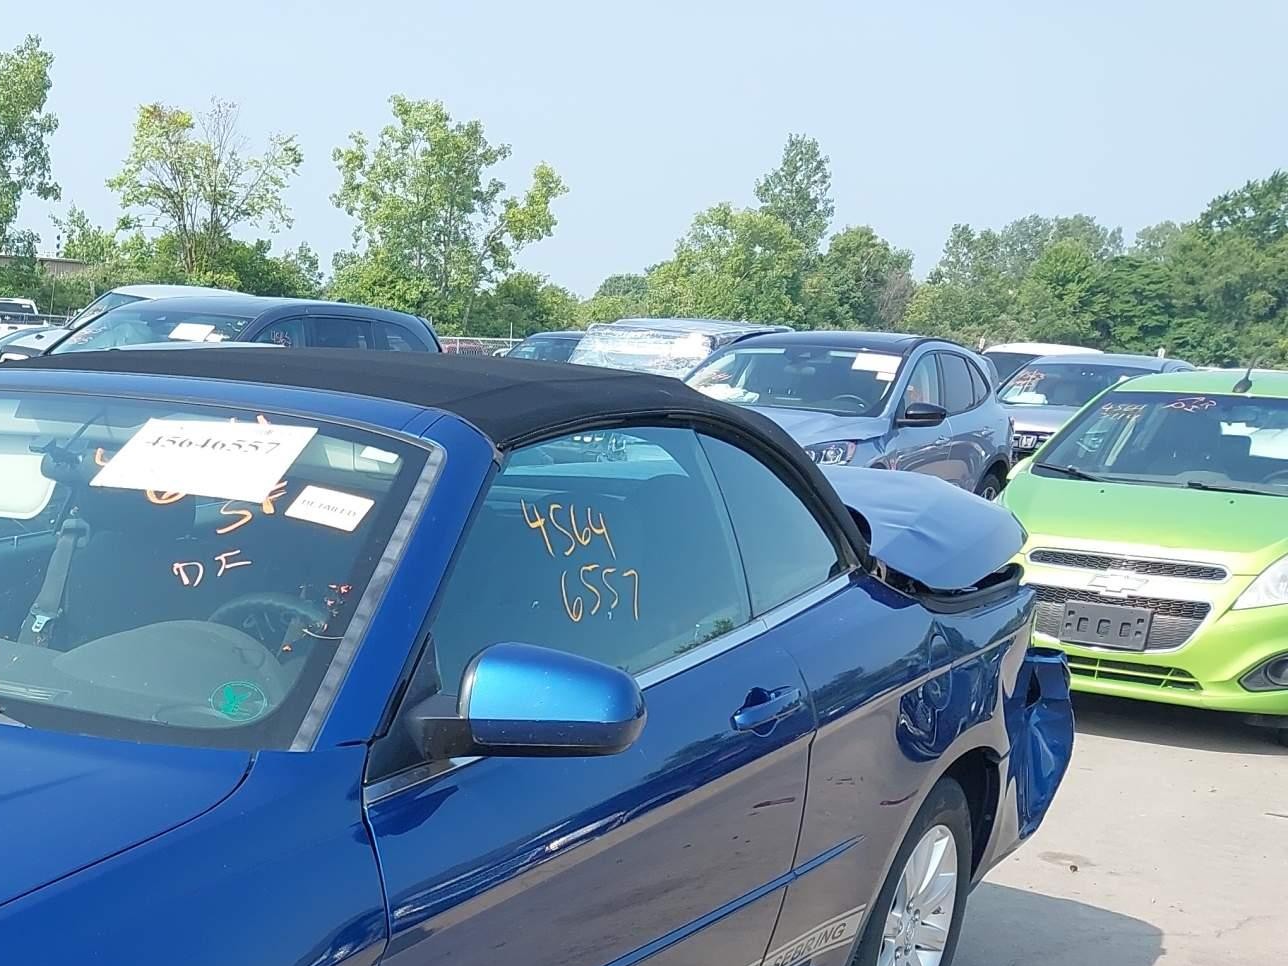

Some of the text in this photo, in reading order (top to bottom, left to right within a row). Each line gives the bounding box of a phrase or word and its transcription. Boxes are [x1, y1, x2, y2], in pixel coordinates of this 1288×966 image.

[144, 435, 281, 455] 45646557
[520, 498, 617, 560] 4564
[561, 563, 640, 622] 6557
